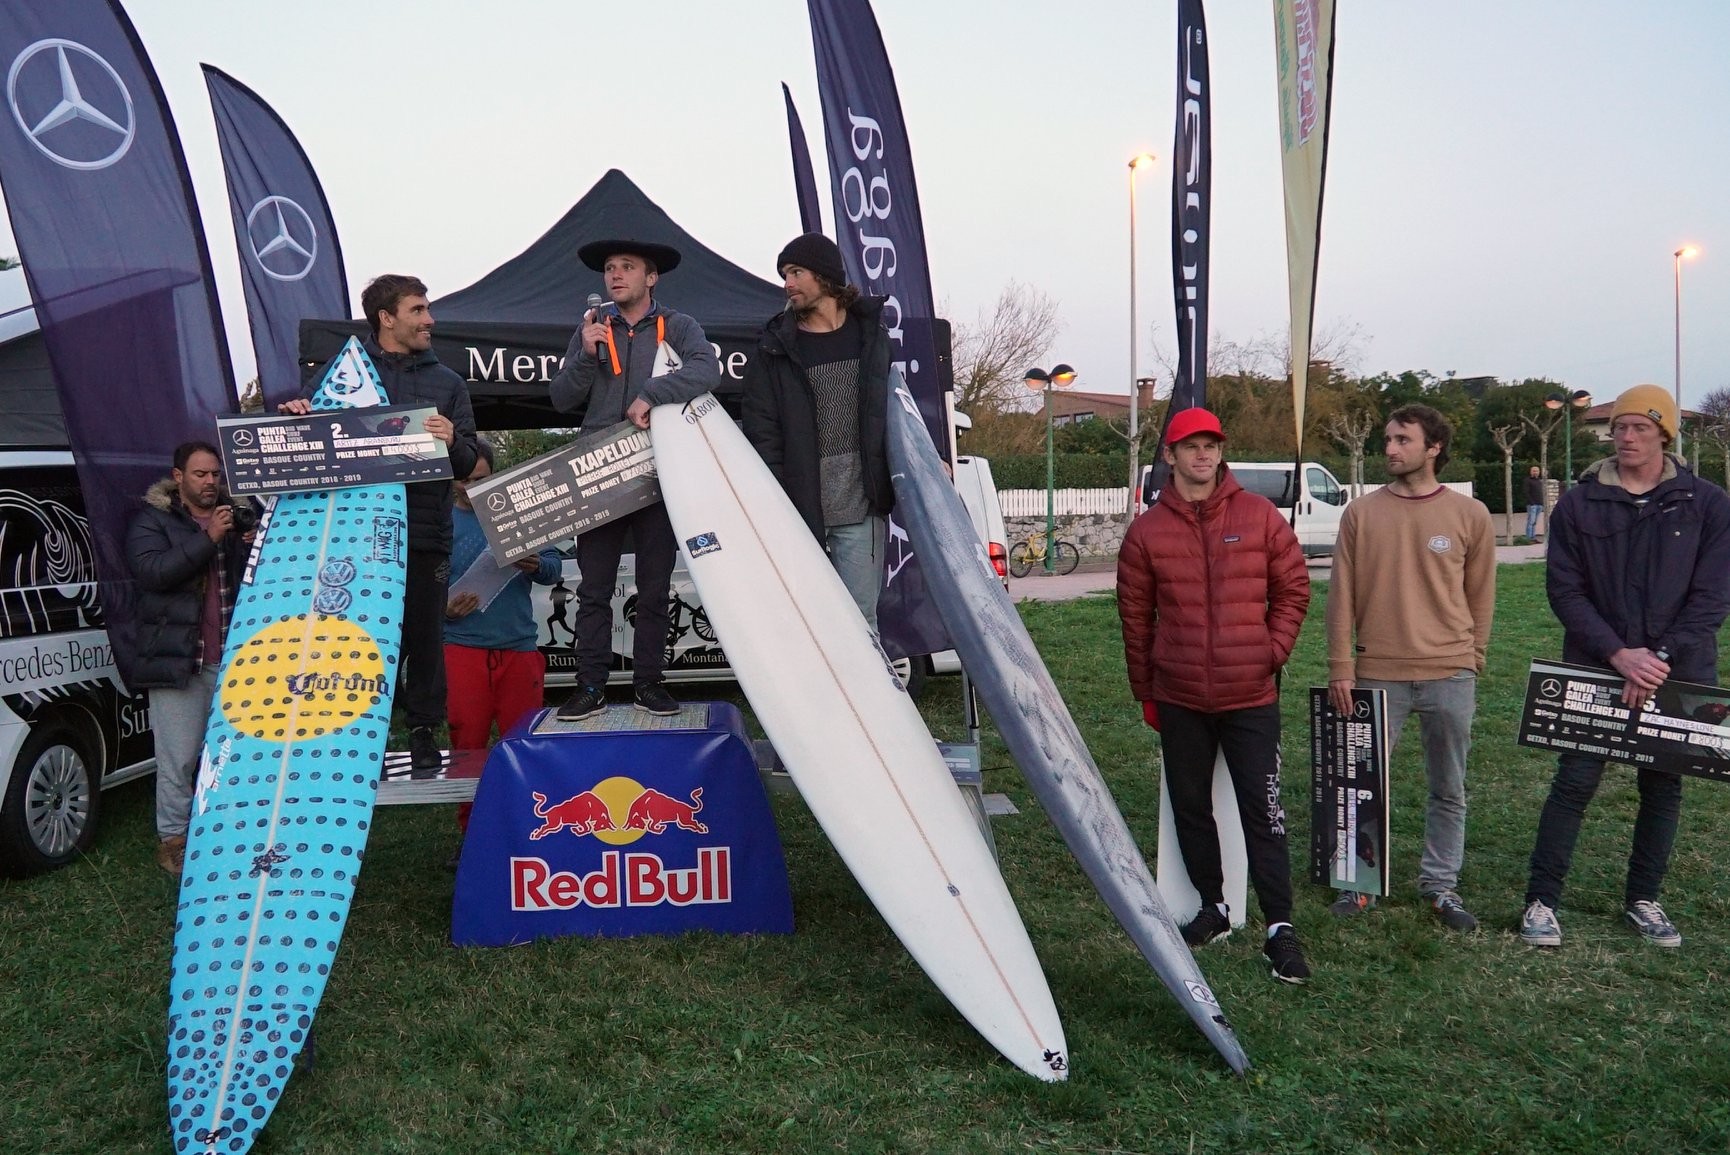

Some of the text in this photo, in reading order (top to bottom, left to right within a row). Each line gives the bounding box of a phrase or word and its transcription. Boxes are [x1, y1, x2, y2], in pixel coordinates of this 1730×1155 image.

[465, 347, 565, 382] Mer
[685, 398, 719, 425] OXBOW
[257, 426, 286, 436] PUNTA
[258, 435, 286, 444] GALEA
[330, 423, 350, 438] 2.
[260, 442, 309, 453] CHALLENGE
[335, 449, 380, 459] PRIZE MONEY
[263, 453, 326, 464] BASQUE COUNTRY
[238, 482, 261, 490] GETXO,
[262, 480, 288, 488] BASQUE
[290, 477, 319, 486] COUNTRY
[344, 473, 361, 481] 2019
[506, 478, 533, 495] PUNTA
[581, 485, 600, 499] PRIZE
[599, 476, 620, 491] MONEY
[510, 487, 535, 504] GALEA
[514, 488, 557, 513] CHALLENGE
[554, 483, 570, 497] XIII
[519, 509, 545, 524] BASQUE
[545, 495, 574, 514] COUNTRY
[243, 496, 278, 584] PUKAS
[505, 546, 526, 558] GETXO,
[525, 536, 548, 550] BASQUE
[548, 524, 574, 540] COUNTRY
[0, 640, 115, 685] cedes-Benz
[682, 651, 728, 664] Montañ
[288, 672, 390, 697] Corona
[1567, 680, 1597, 694] PUNTA
[1565, 690, 1594, 703] GALEA
[1563, 700, 1630, 720] CHALLENGE XIII
[1561, 713, 1628, 732] BASQUE COUNTRY
[1336, 722, 1344, 746] BASQUE
[1347, 722, 1356, 764] CHALLENGE
[1355, 723, 1363, 746] GALEA
[1363, 723, 1372, 748] PUNTA
[1637, 726, 1687, 742] PRIZE MONEY
[1551, 738, 1577, 750] BASQUE
[1578, 743, 1610, 755] COUNTRY
[1610, 749, 1629, 759] 2018
[1635, 753, 1654, 763] 2019
[1357, 789, 1373, 805] 6.
[511, 847, 732, 911] Red Bull
